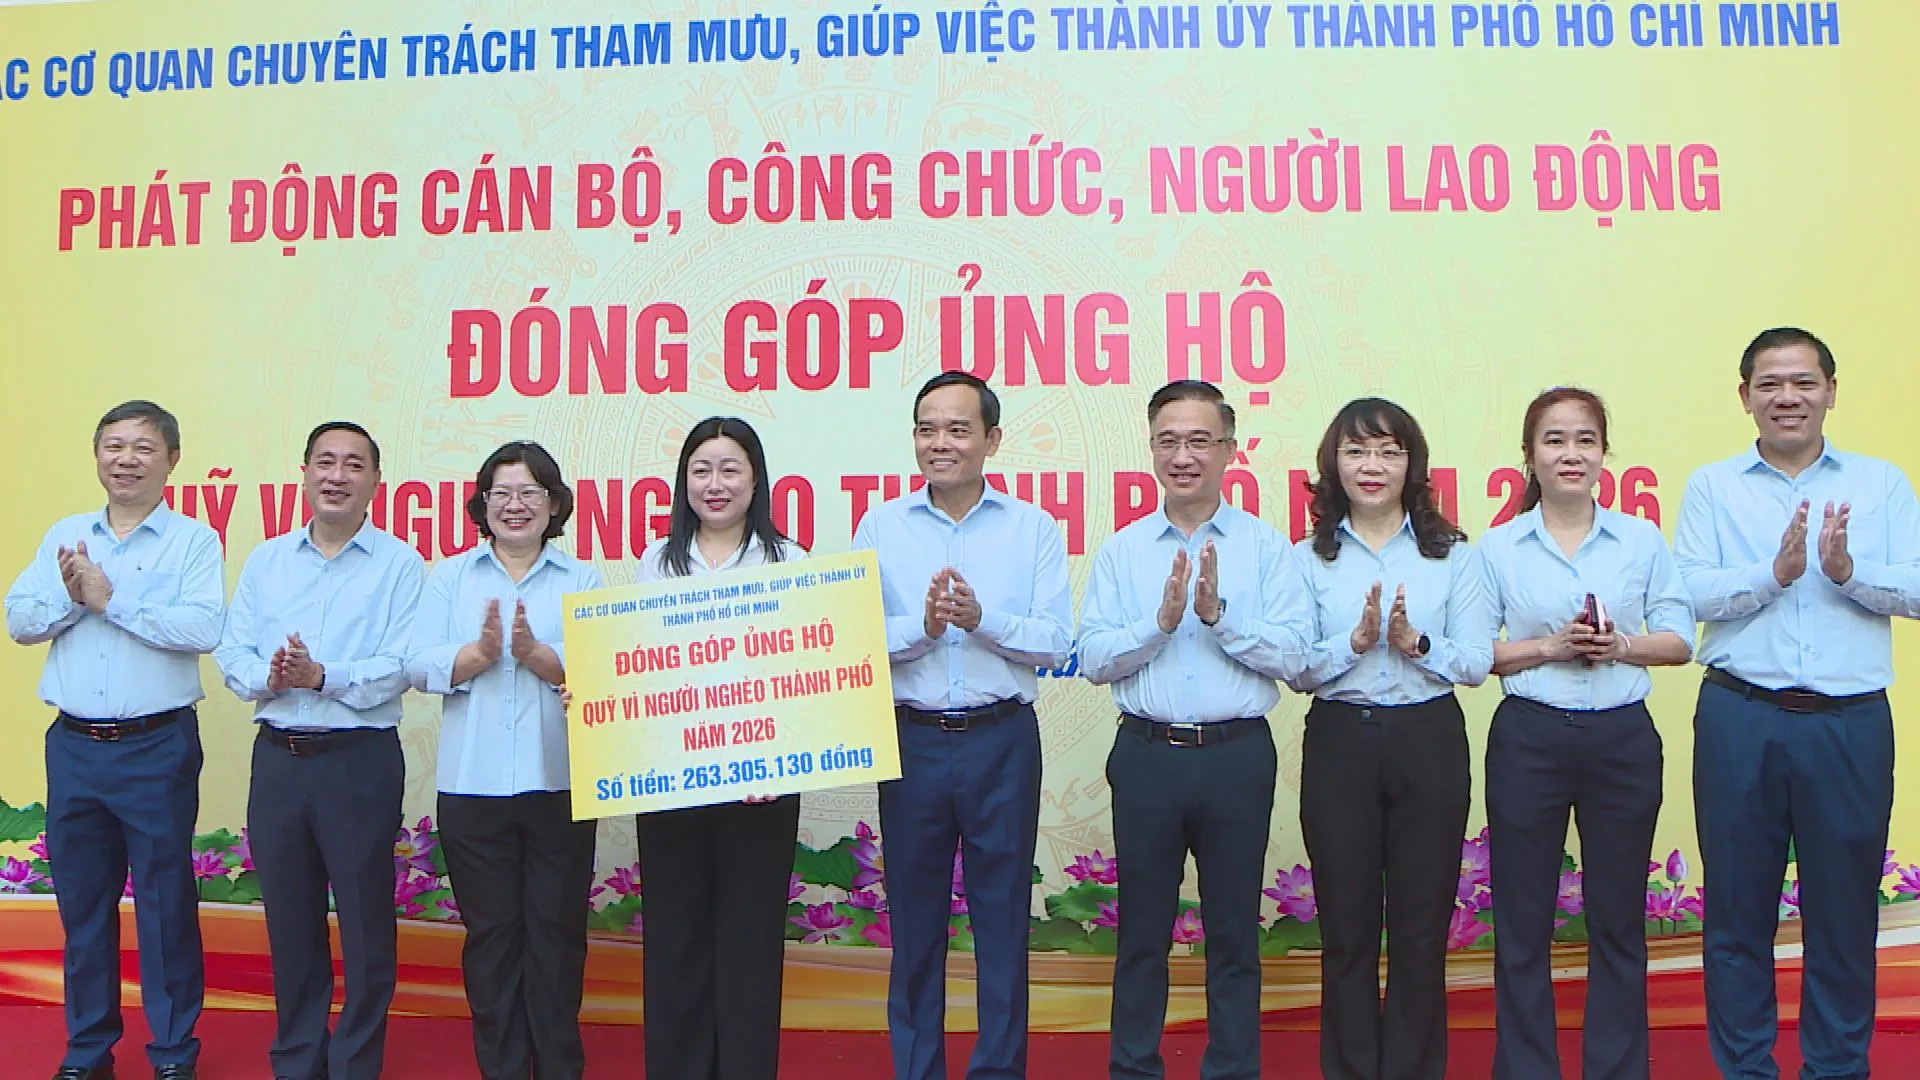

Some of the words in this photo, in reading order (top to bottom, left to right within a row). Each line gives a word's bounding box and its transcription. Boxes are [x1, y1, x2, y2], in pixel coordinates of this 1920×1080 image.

[44, 50, 97, 99] CƠ
[108, 47, 213, 98] QUAN
[227, 30, 388, 88] CHUYÊN
[402, 23, 537, 76] TRÁCH
[551, 21, 671, 69] THAM
[687, 14, 800, 65] MƯU,
[816, 4, 921, 59] GIÚP
[936, 1, 1035, 63] VIỆC
[1719, 2, 1840, 46] MINH
[58, 169, 211, 251] PHÁT
[228, 163, 398, 257] ĐỘNG
[421, 153, 552, 235] CÁN
[576, 145, 681, 243] BỘ,
[708, 141, 893, 225] CÔNG
[918, 134, 1124, 224] CHỨC,
[1150, 128, 1362, 214] NGƯỜI
[1386, 143, 1511, 213] LAO
[1532, 129, 1722, 227] ĐỘNG
[447, 287, 688, 399] ĐÓNG
[723, 278, 904, 393] GÓP
[938, 263, 1130, 388] ỦNG
[1164, 271, 1287, 405] HỘ
[574, 605, 594, 620] CÁC
[611, 601, 637, 617] QUAN
[639, 594, 677, 611] CHUYÊN
[680, 589, 710, 605] TRÁCH
[712, 585, 739, 600] THAM
[769, 576, 792, 593] GIÚP
[795, 573, 817, 590] VIỆC
[819, 566, 851, 585] THÀNH
[662, 610, 694, 627] THÀNH
[734, 600, 750, 617] CHÍ
[753, 599, 779, 614] MINH
[615, 643, 681, 677] ĐÓNG
[688, 634, 736, 667] GÓP
[744, 625, 794, 659] ỦNG
[801, 617, 835, 653] HỘ
[582, 694, 616, 728] QUỸ
[621, 691, 639, 721] VÌ
[644, 683, 700, 718] NGƯỜI
[704, 675, 766, 711] NGHÈO
[770, 668, 831, 701] THÀNH
[836, 654, 874, 691] PHỐ
[683, 719, 726, 752] NĂM
[732, 717, 776, 745] 2026
[596, 772, 624, 801] Số
[630, 768, 676, 797] tiền:
[683, 751, 813, 791] 263.305.130
[820, 743, 873, 772] đồng
